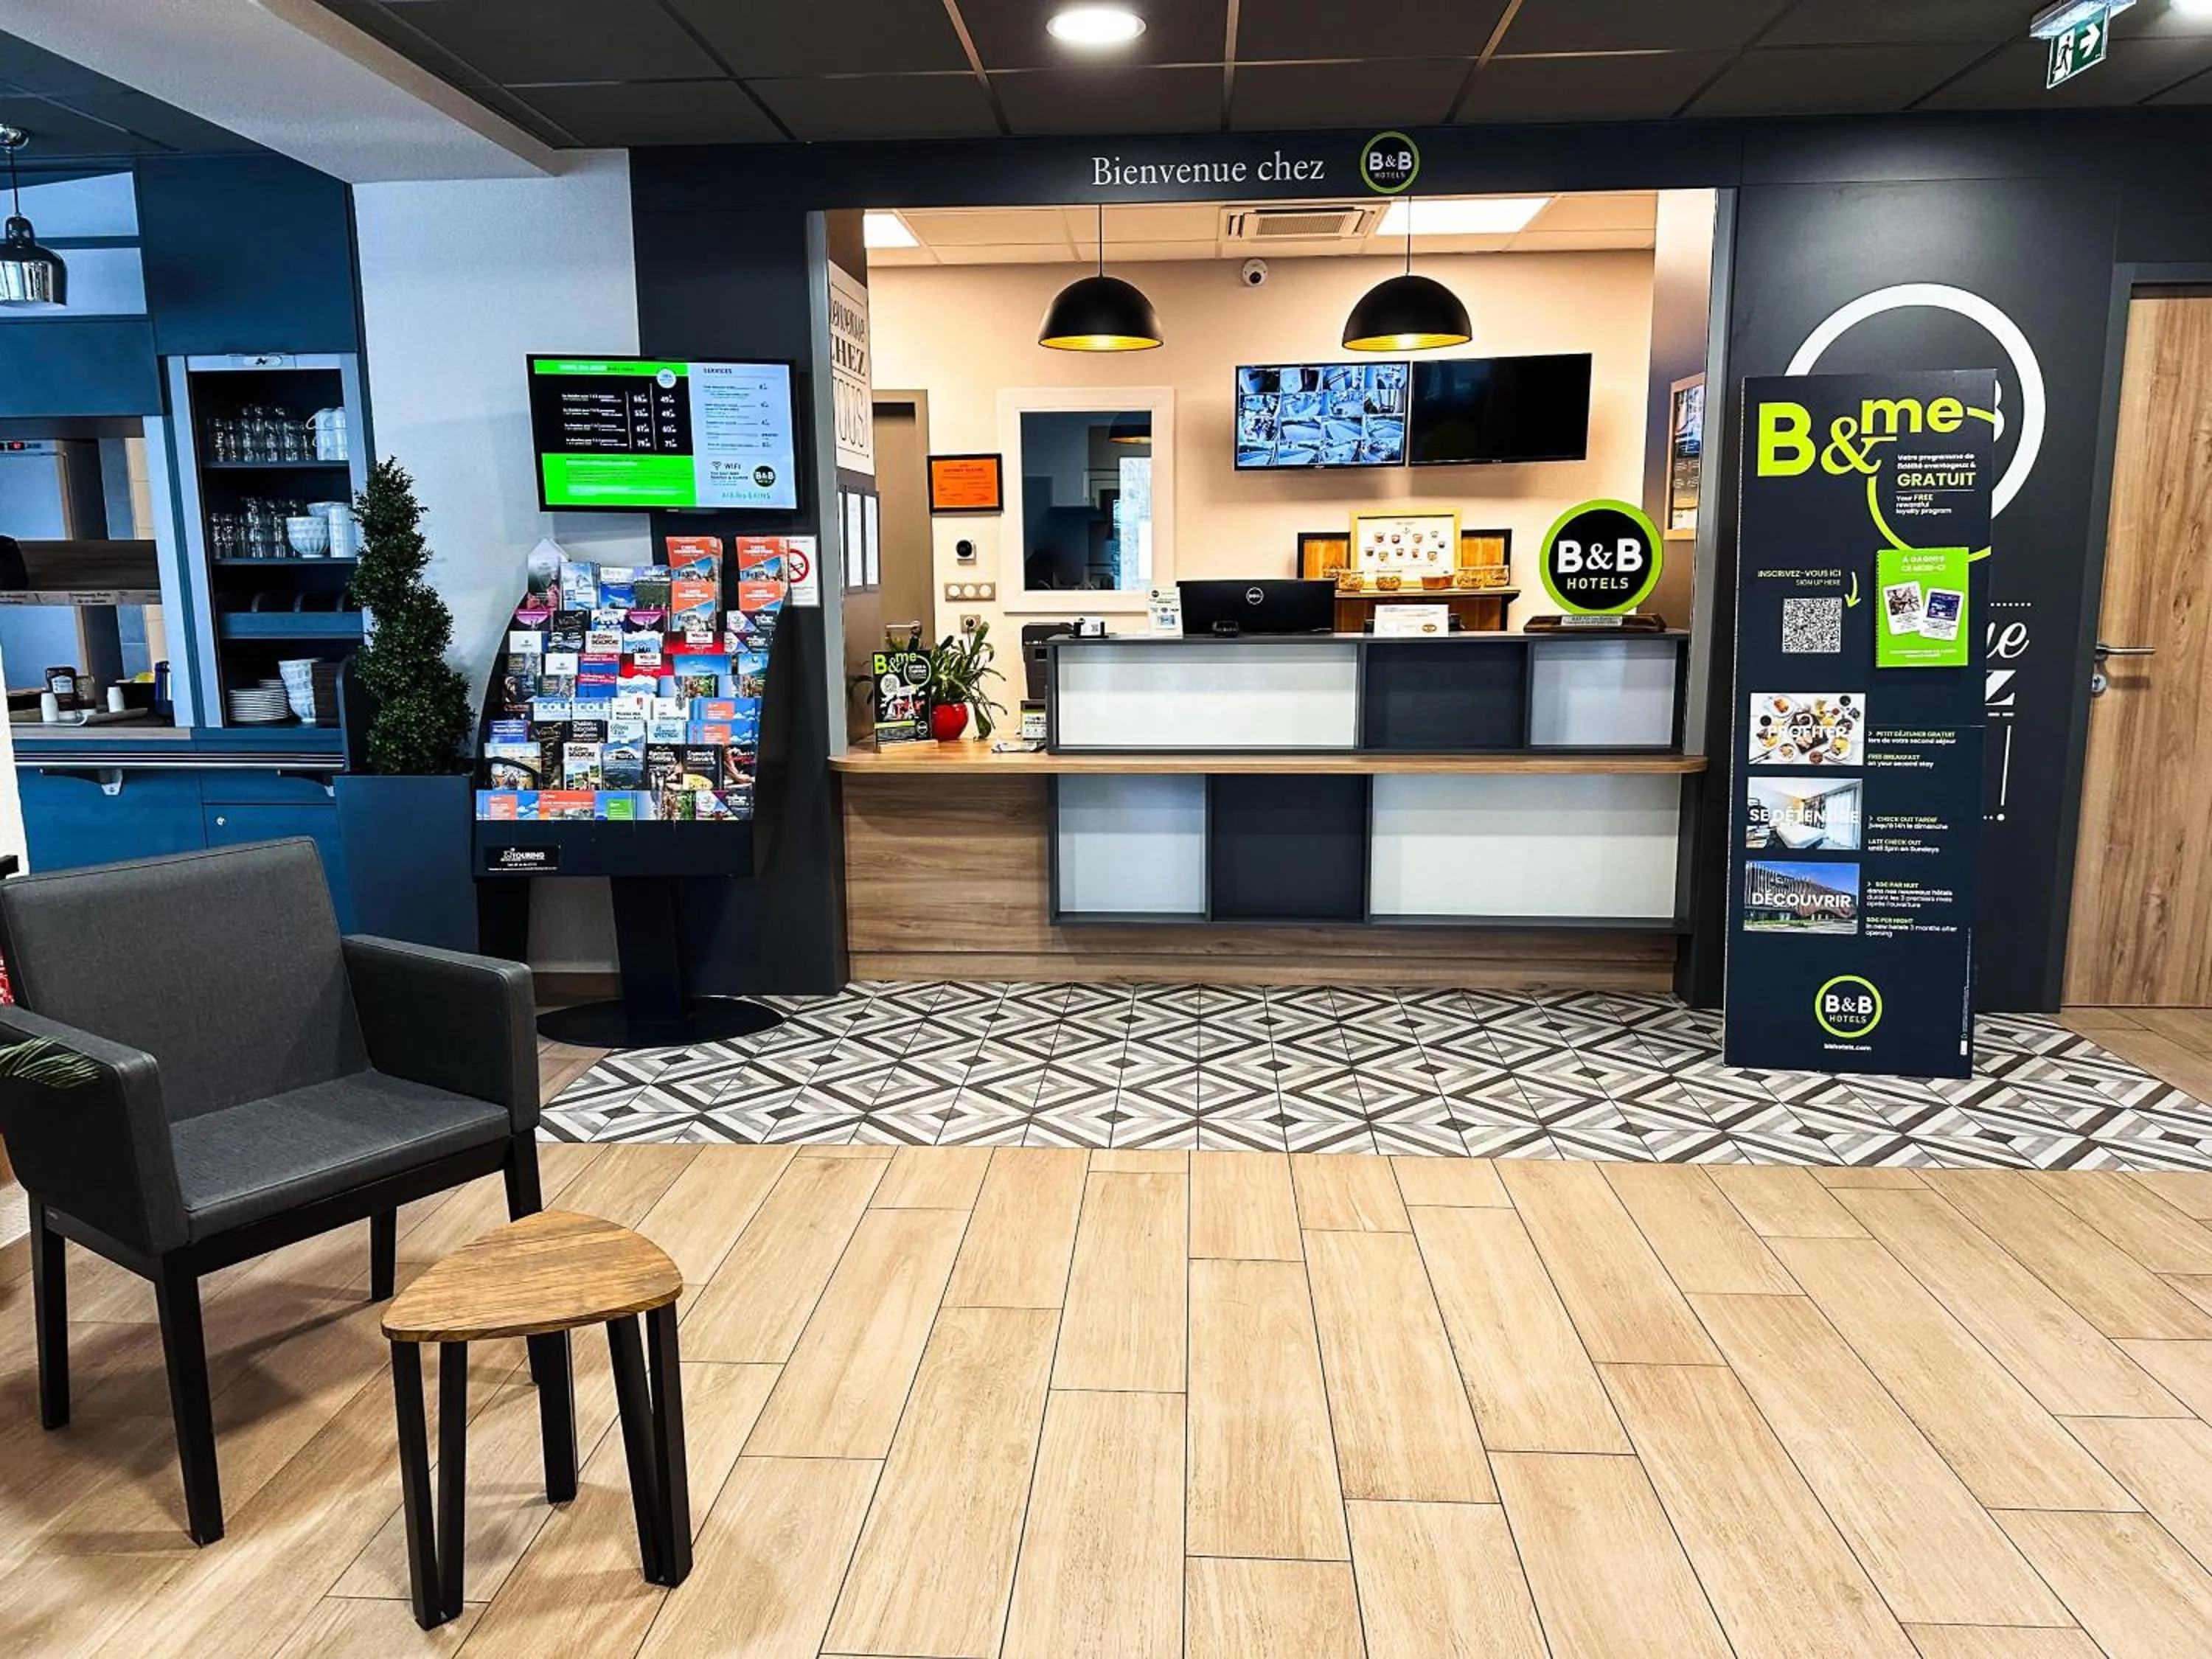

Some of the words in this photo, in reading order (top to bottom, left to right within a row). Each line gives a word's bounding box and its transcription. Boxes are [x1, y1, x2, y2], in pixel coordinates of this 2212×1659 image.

[1368, 151, 1413, 170] B&B
[1091, 156, 1247, 186] Bienvenue
[1257, 150, 1326, 183] chez
[1374, 170, 1406, 179] HOTELS
[831, 333, 866, 377] HEZ
[1919, 453, 1964, 462] programme
[1896, 472, 1976, 487] GRATUIT
[1557, 538, 1644, 574] B&B
[1757, 569, 1829, 577] INSCRIVEZ-VOUS
[1567, 577, 1629, 590] HOTELS
[1767, 724, 1846, 738] PROFITER
[1749, 809, 1770, 821] SE
[1751, 888, 1852, 908] DÉCOUVRIR
[1825, 994, 1873, 1014] B&B
[1829, 1015, 1867, 1023] HOTELS
